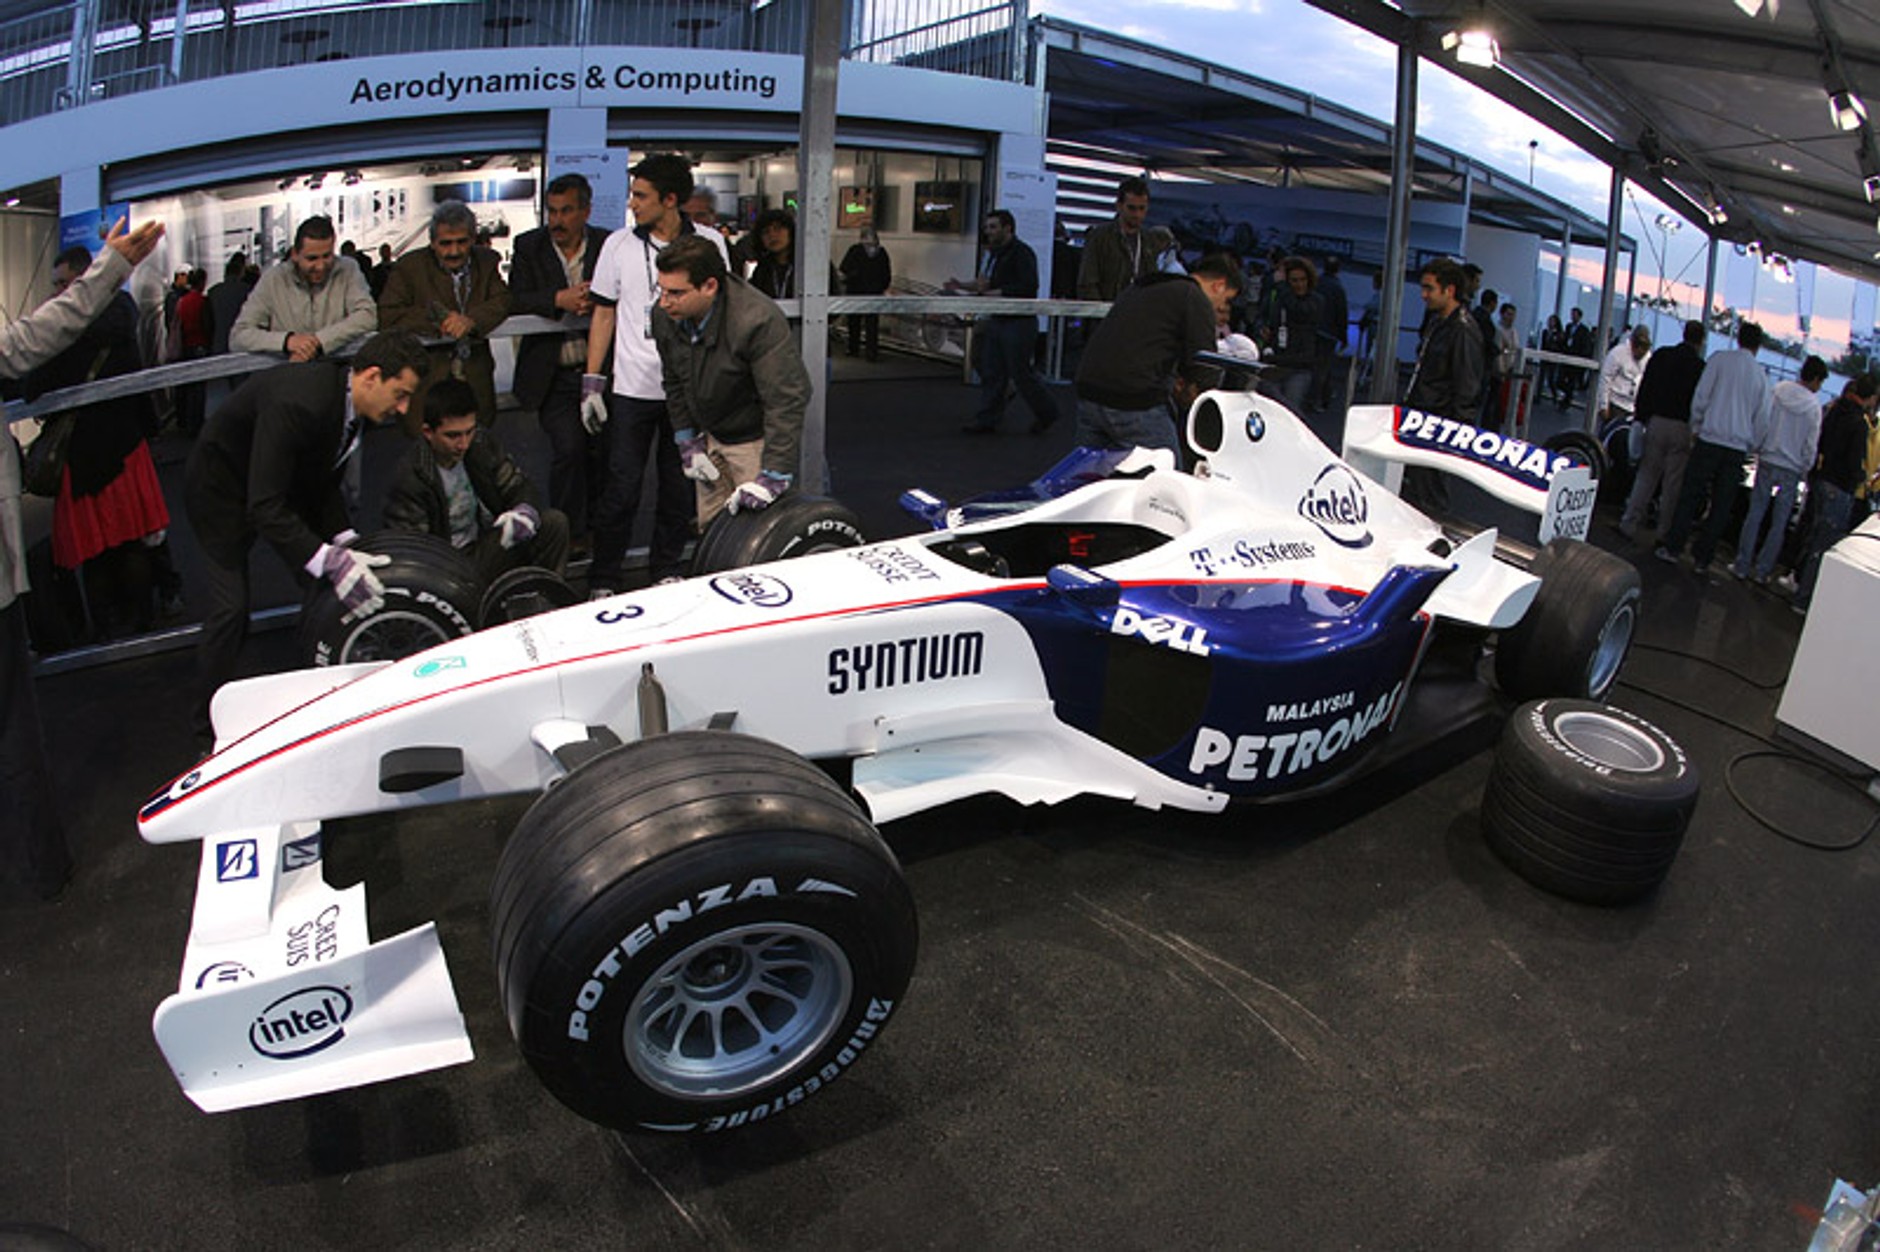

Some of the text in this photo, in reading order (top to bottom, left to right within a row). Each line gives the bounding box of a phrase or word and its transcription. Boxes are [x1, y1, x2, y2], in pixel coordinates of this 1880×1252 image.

[351, 65, 777, 104] Aerodynamics & Computing
[1307, 485, 1364, 525] intel
[1556, 486, 1595, 513] CREDIT
[596, 605, 644, 624] 3
[1111, 607, 1211, 657] DELL
[828, 631, 984, 696] SYNTIUM
[1266, 691, 1355, 722] MALAYSIA
[567, 877, 779, 1042] POTENZA
[257, 998, 338, 1044] intel
[703, 998, 894, 1133] BRIDGESTONE
